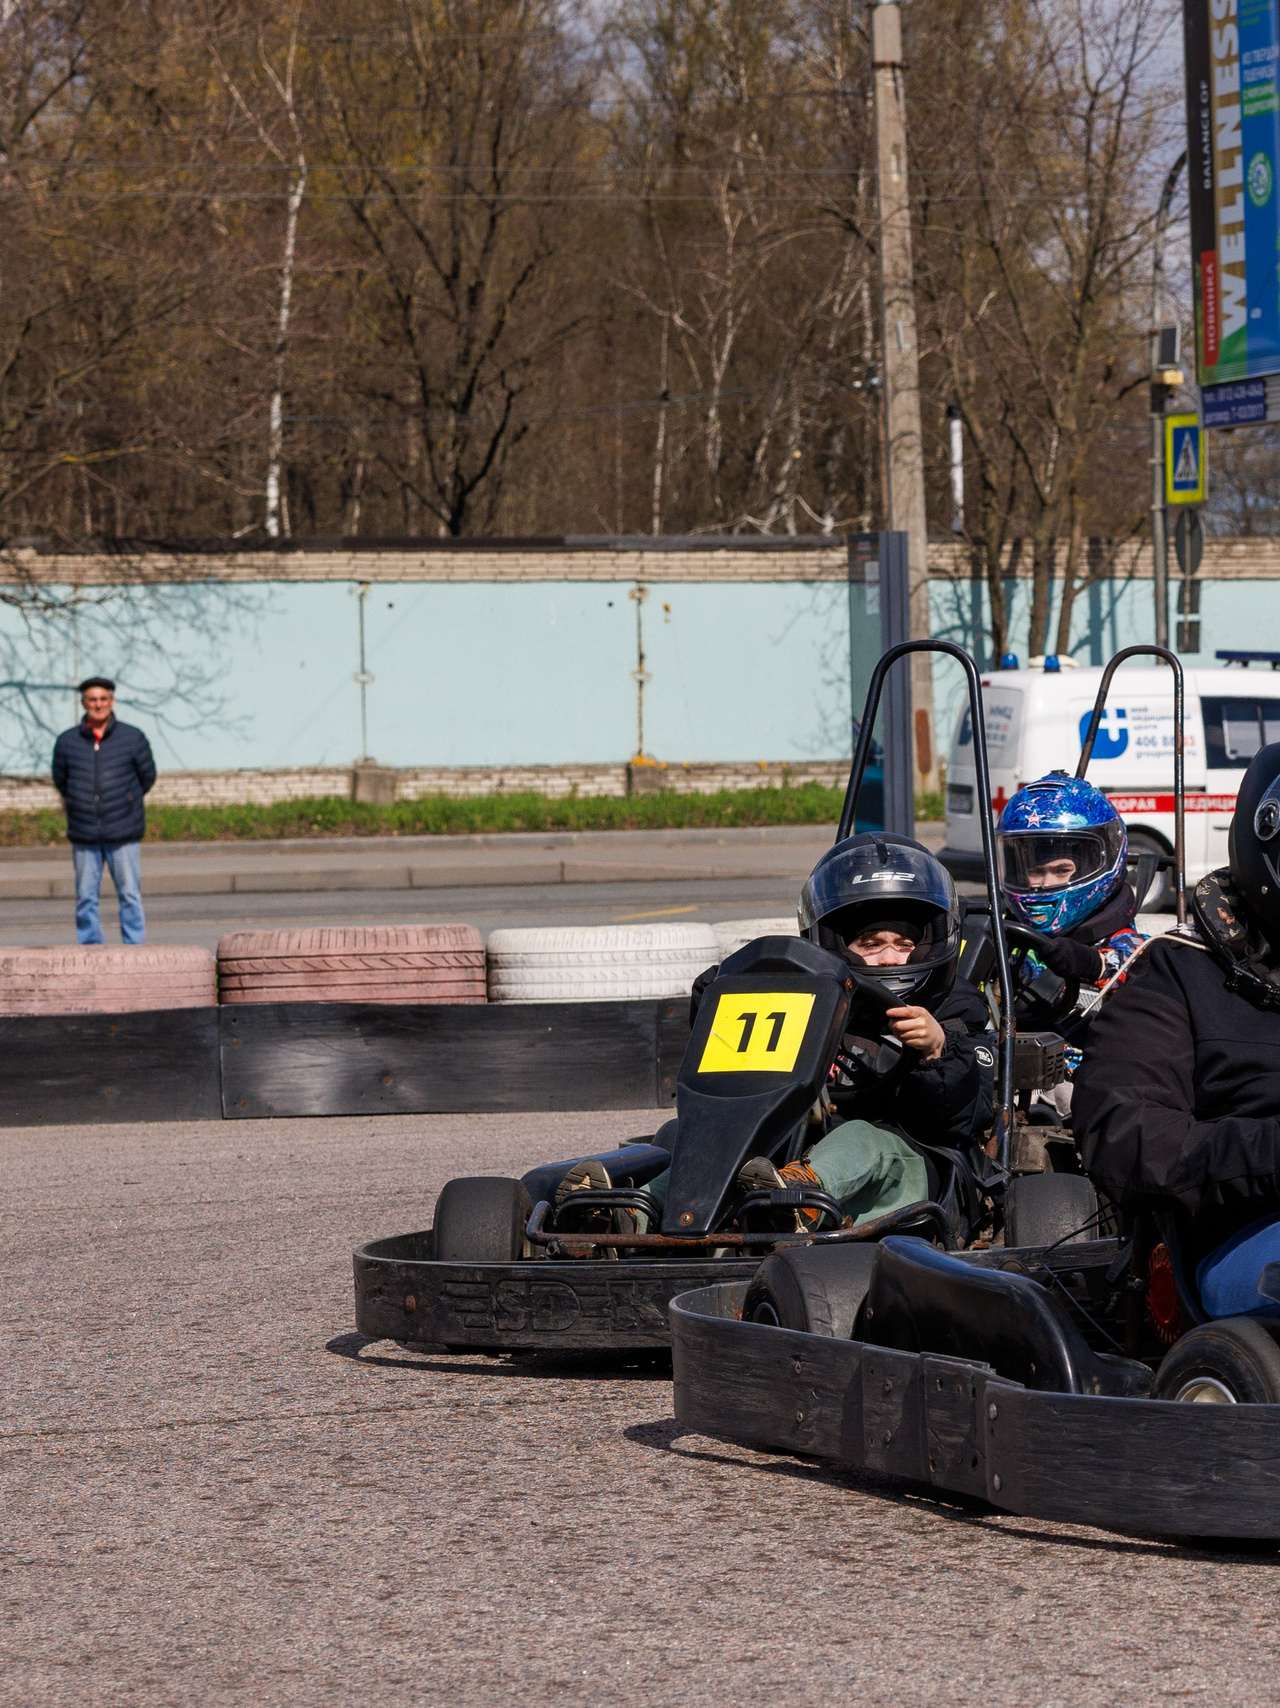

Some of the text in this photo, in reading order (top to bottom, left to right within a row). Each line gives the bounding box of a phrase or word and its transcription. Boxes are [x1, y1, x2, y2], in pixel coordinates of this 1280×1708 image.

[1200, 80, 1212, 190] BALANCE OF
[1205, 262, 1216, 352] НОВИНКА
[1112, 798, 1157, 812] КОРАЯ
[852, 871, 916, 885] LS2
[736, 1012, 787, 1053] 11
